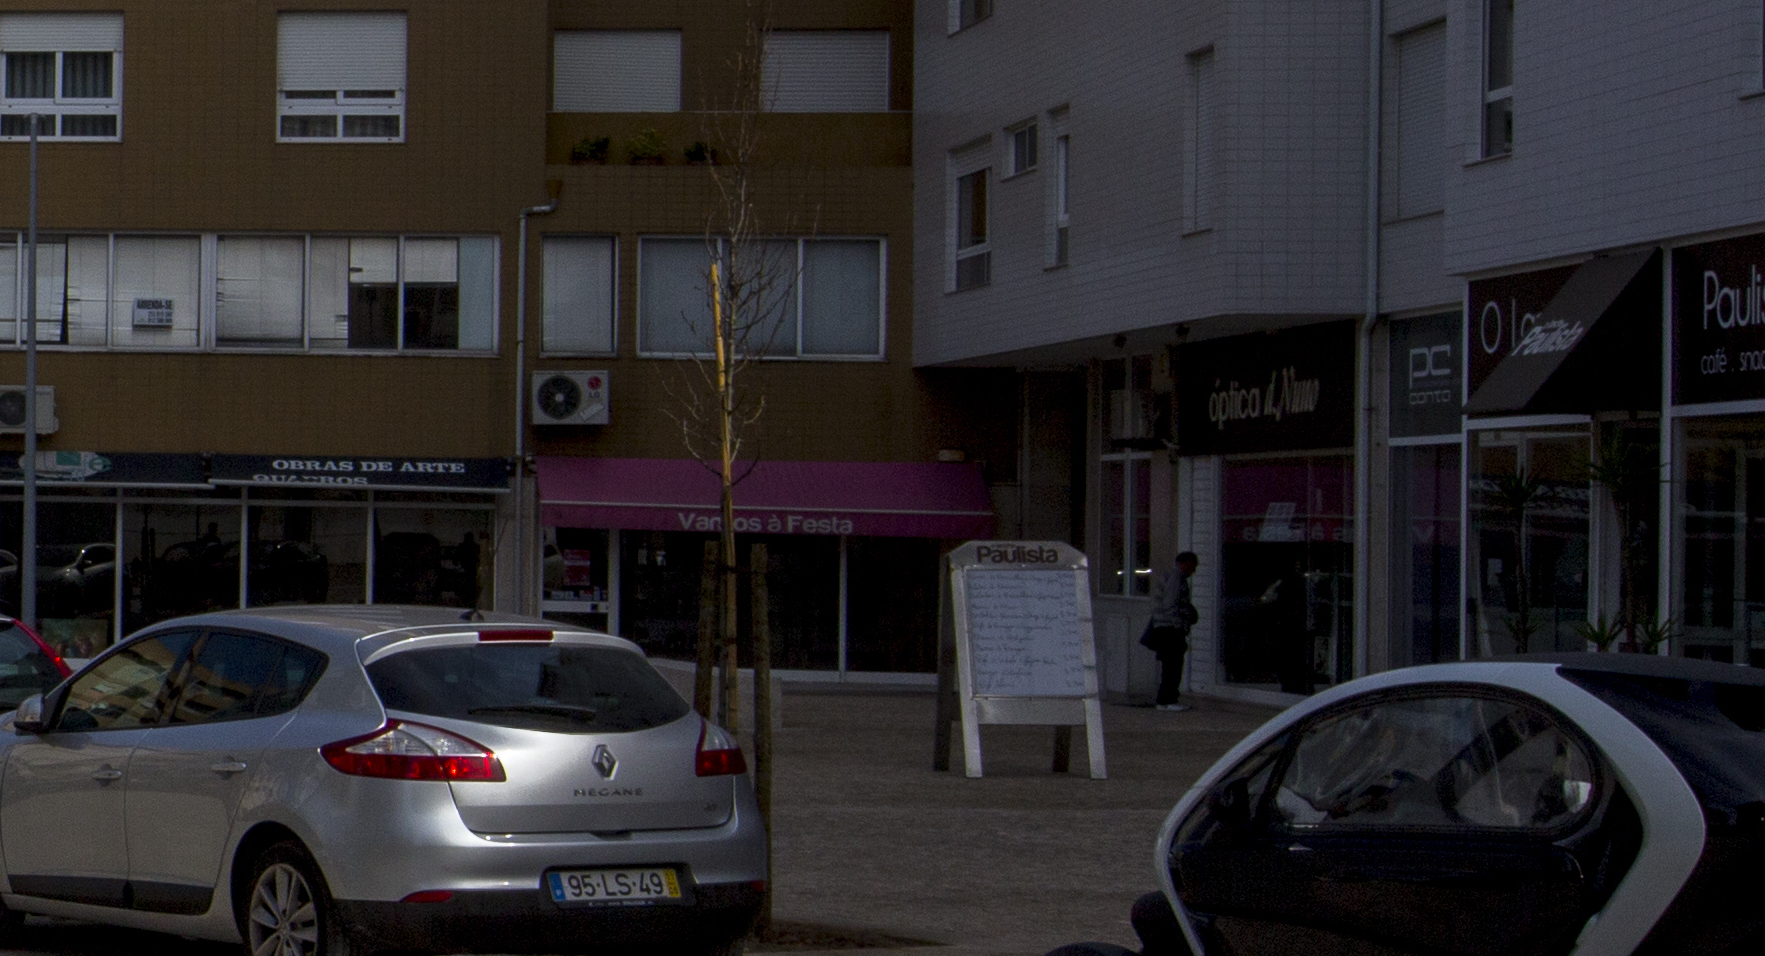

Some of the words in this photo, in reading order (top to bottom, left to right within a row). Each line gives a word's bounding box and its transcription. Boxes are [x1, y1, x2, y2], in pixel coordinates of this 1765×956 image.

[1702, 263, 1765, 330] Pauli
[1701, 346, 1727, 376] café
[1209, 377, 1262, 430] óptica
[271, 458, 354, 472] OBRAS
[359, 460, 393, 472] DE
[399, 461, 466, 474] ARTE
[768, 514, 782, 533] à
[787, 515, 854, 534] Festa
[976, 545, 1058, 564] Paulista
[573, 787, 644, 797] MEGANE
